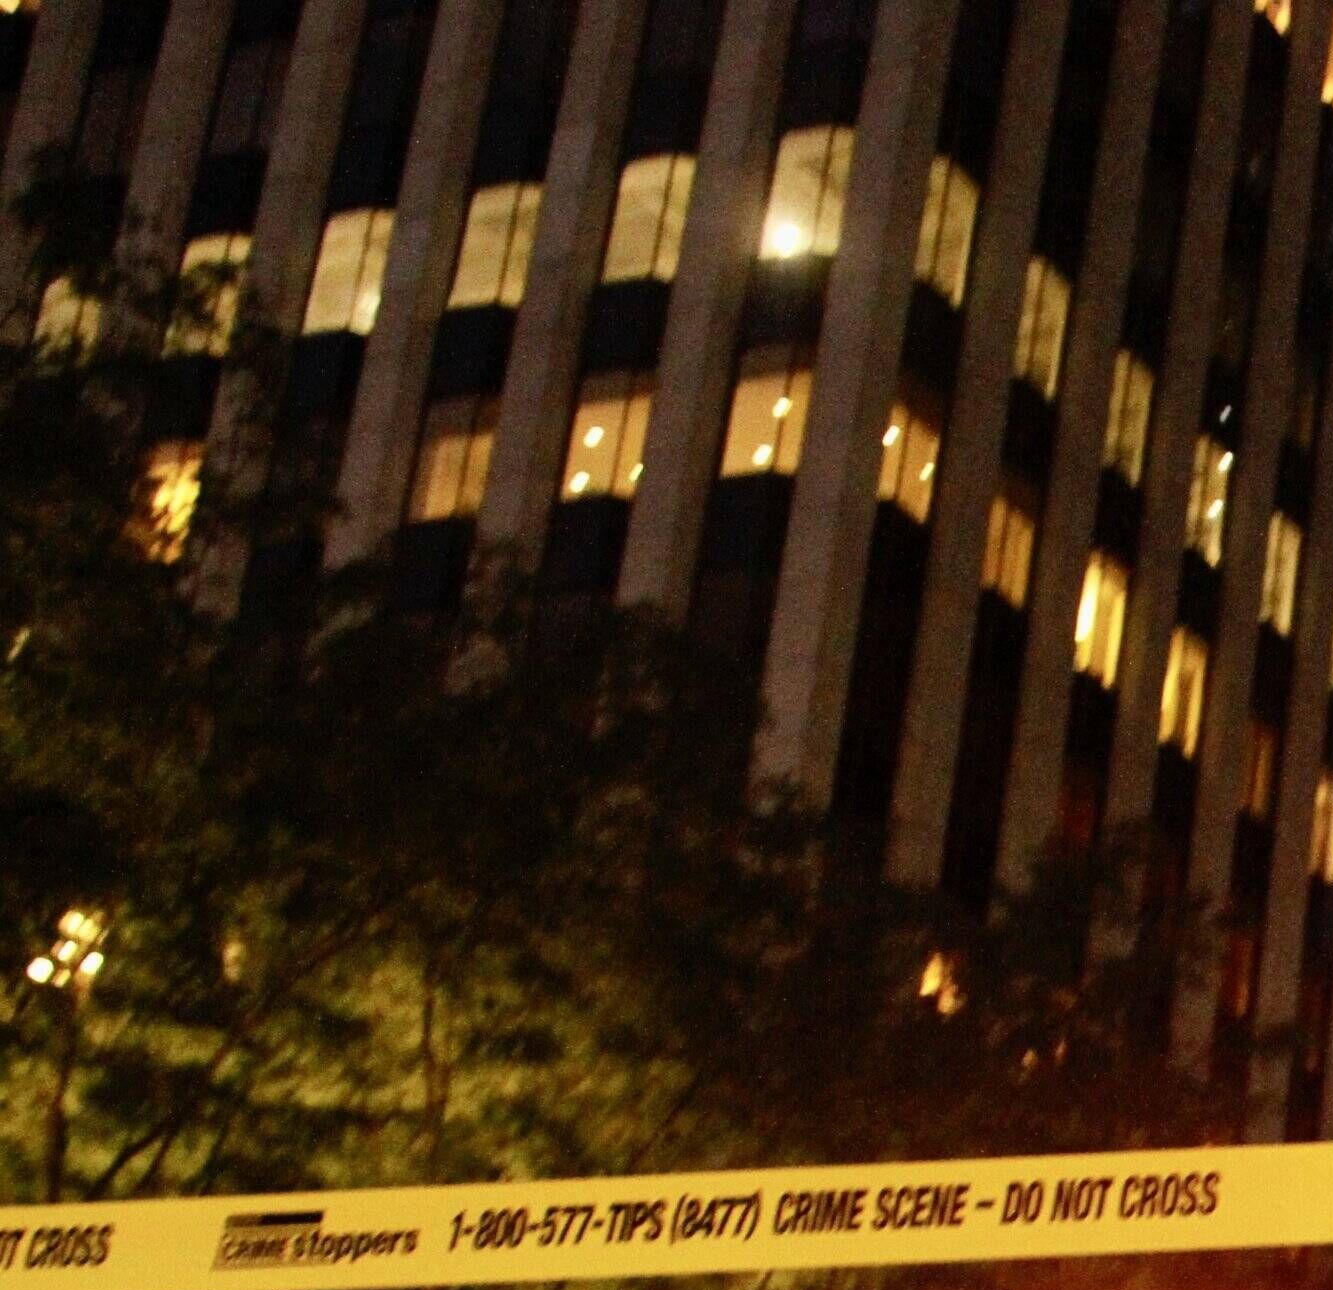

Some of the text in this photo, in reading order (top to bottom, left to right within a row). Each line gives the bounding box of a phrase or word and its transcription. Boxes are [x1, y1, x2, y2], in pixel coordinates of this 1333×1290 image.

[449, 1199, 668, 1252] 1-800-577-TIPS
[670, 1189, 762, 1245] (8477)
[774, 1188, 869, 1236] CRIME
[872, 1183, 971, 1232] SCENE
[1001, 1179, 1044, 1225] DO
[1050, 1175, 1115, 1222] NOT
[1119, 1171, 1220, 1218] CROSS
[25, 1222, 114, 1270] CROSS
